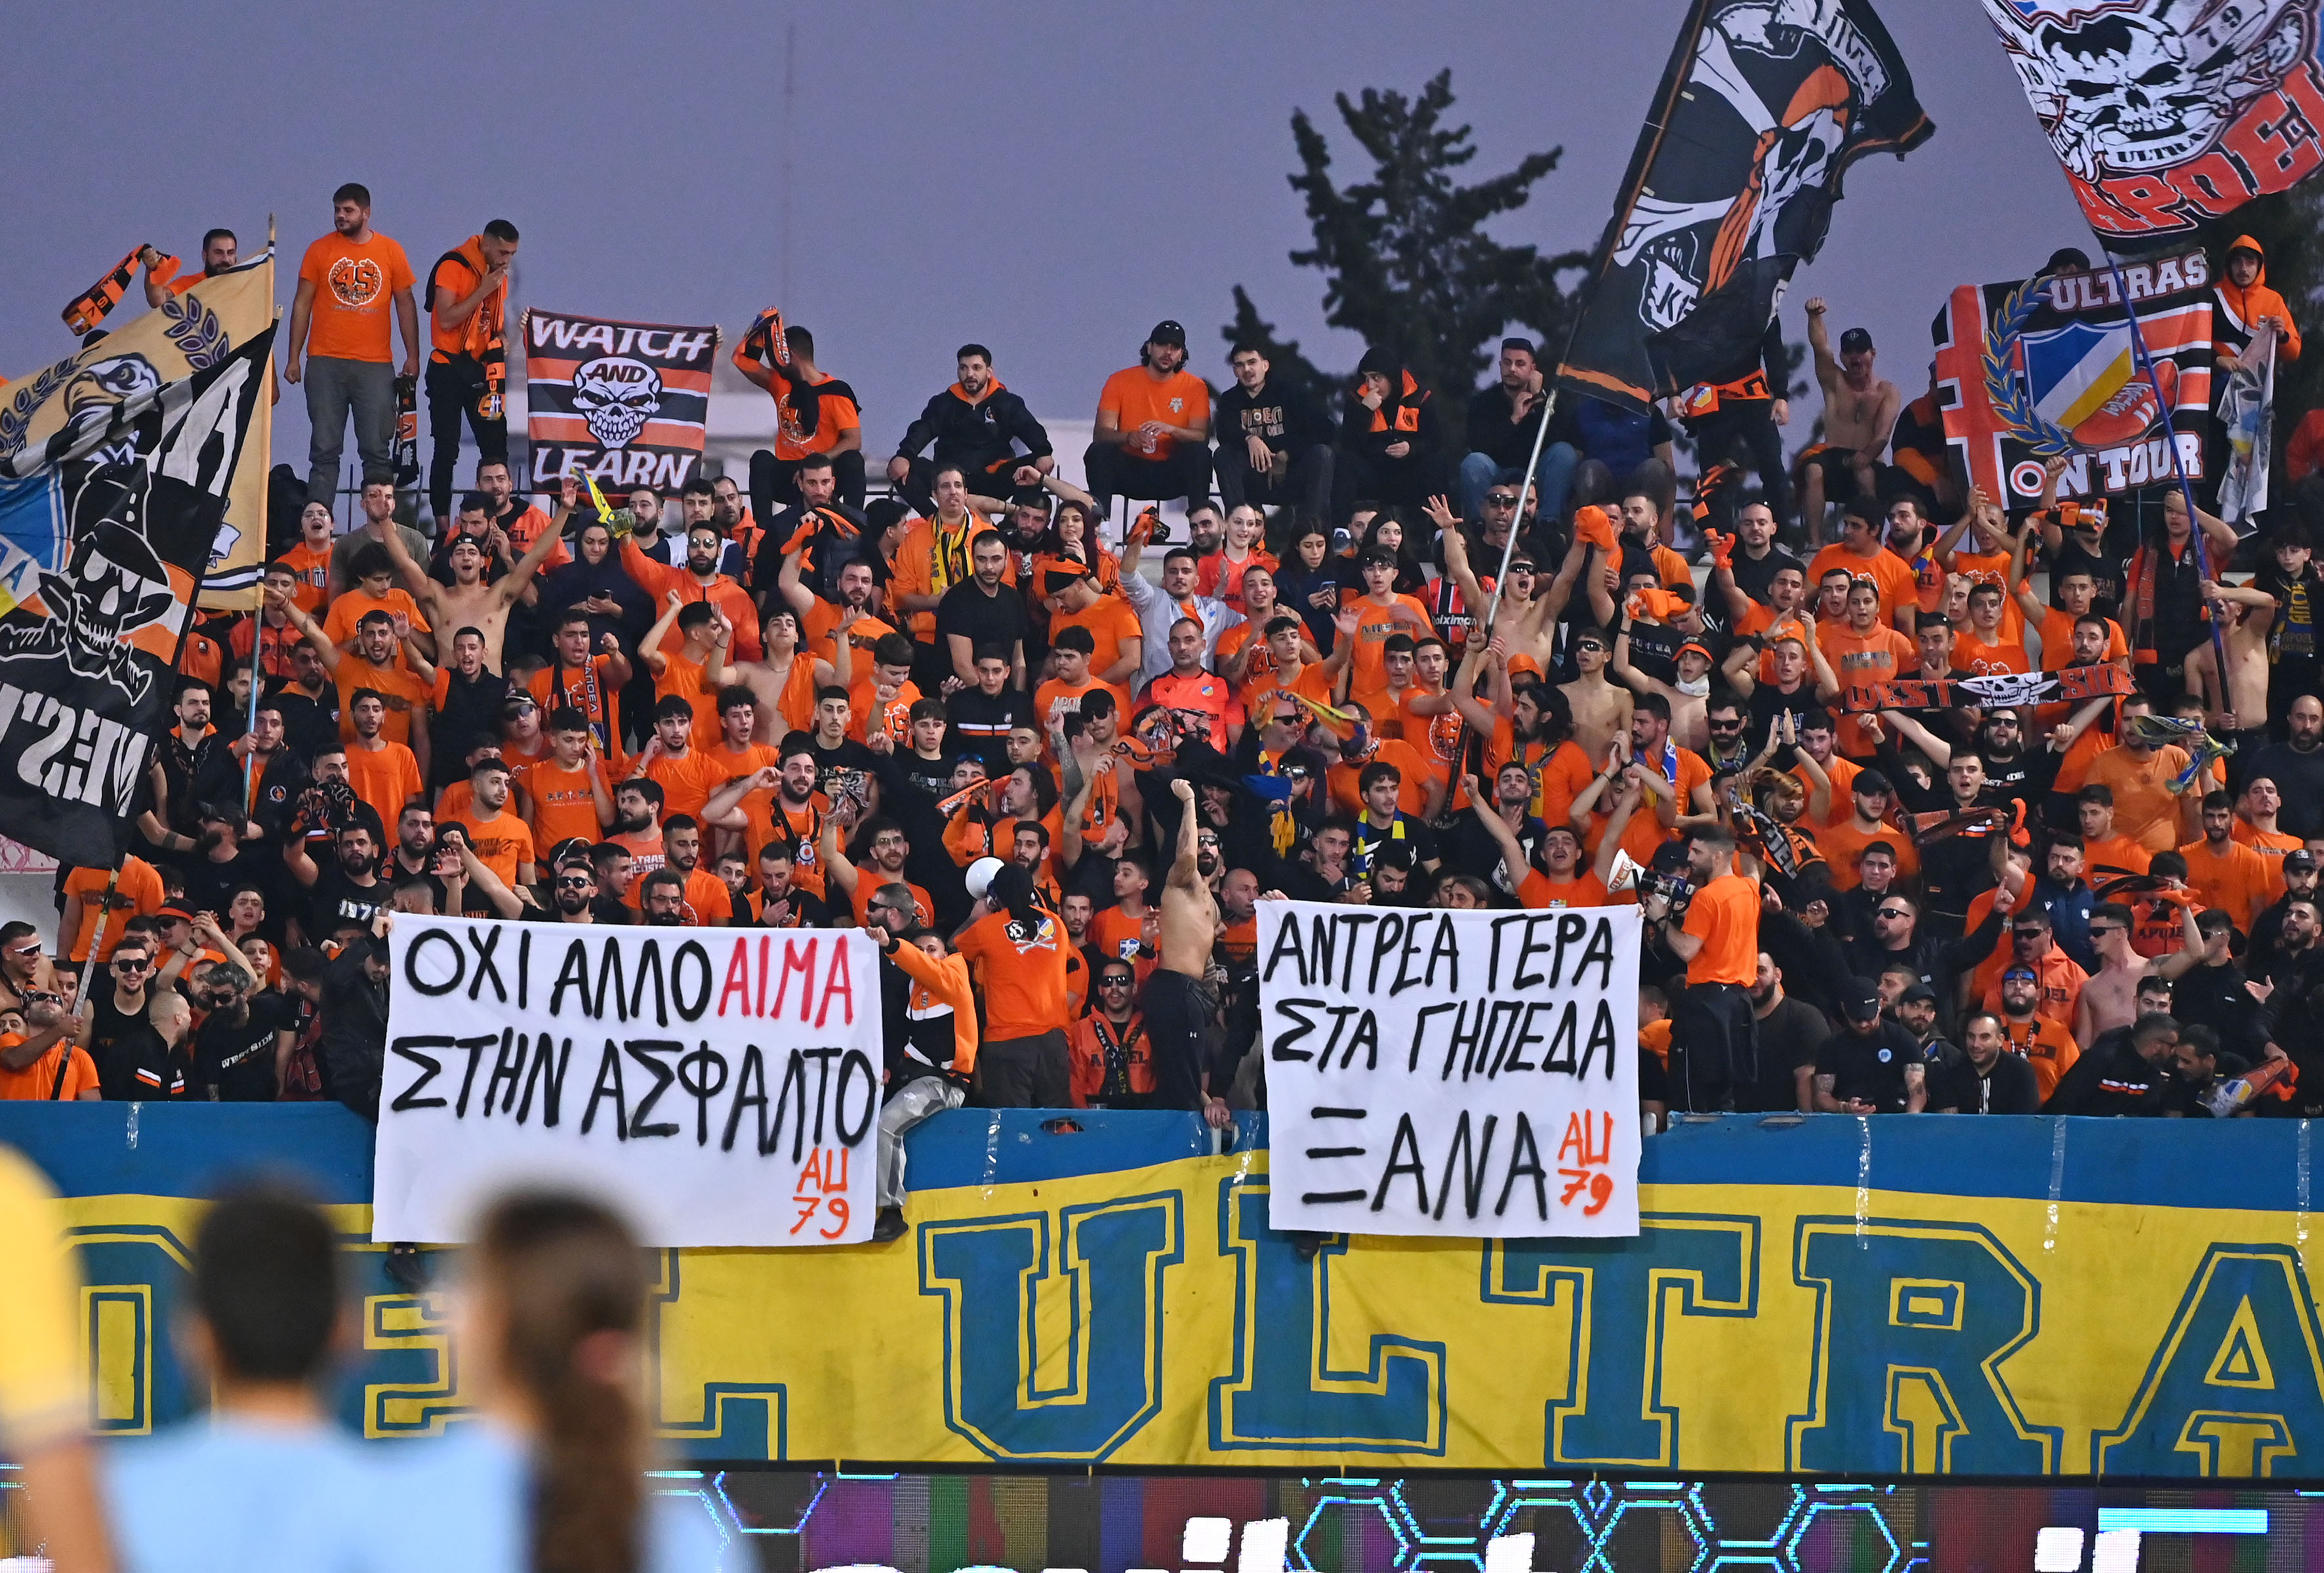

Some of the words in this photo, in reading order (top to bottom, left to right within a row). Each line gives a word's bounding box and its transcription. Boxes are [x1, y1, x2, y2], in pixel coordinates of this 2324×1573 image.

[335, 265, 375, 296] 45
[2048, 252, 2209, 313] ULTRAS
[531, 315, 714, 361] WATCH
[586, 363, 648, 384] AND
[533, 447, 697, 491] LEARN
[2100, 430, 2203, 493] TOUR
[1845, 679, 1959, 713] WEST
[628, 853, 666, 865] LTRAS
[404, 925, 531, 1010] ΟΧΙ
[549, 936, 713, 1028] ΑΛΛΟ
[718, 934, 853, 1029] ΑΙΜΑ
[1263, 912, 1459, 997] ΑΝΤΡΕΑ
[1488, 913, 1614, 993] ΓΕΡΑ
[1271, 998, 1378, 1073] ΣΤΑ
[1409, 998, 1616, 1082] ΓΗΠΕΔΑ
[392, 1027, 572, 1128] ΣΤΗΝ
[581, 1038, 877, 1164] ΑΣΦΑΛΤΟ
[1301, 1107, 1547, 1221] ΞΑΝΑ
[1557, 1168, 1614, 1216] 79
[790, 1196, 849, 1240] 79
